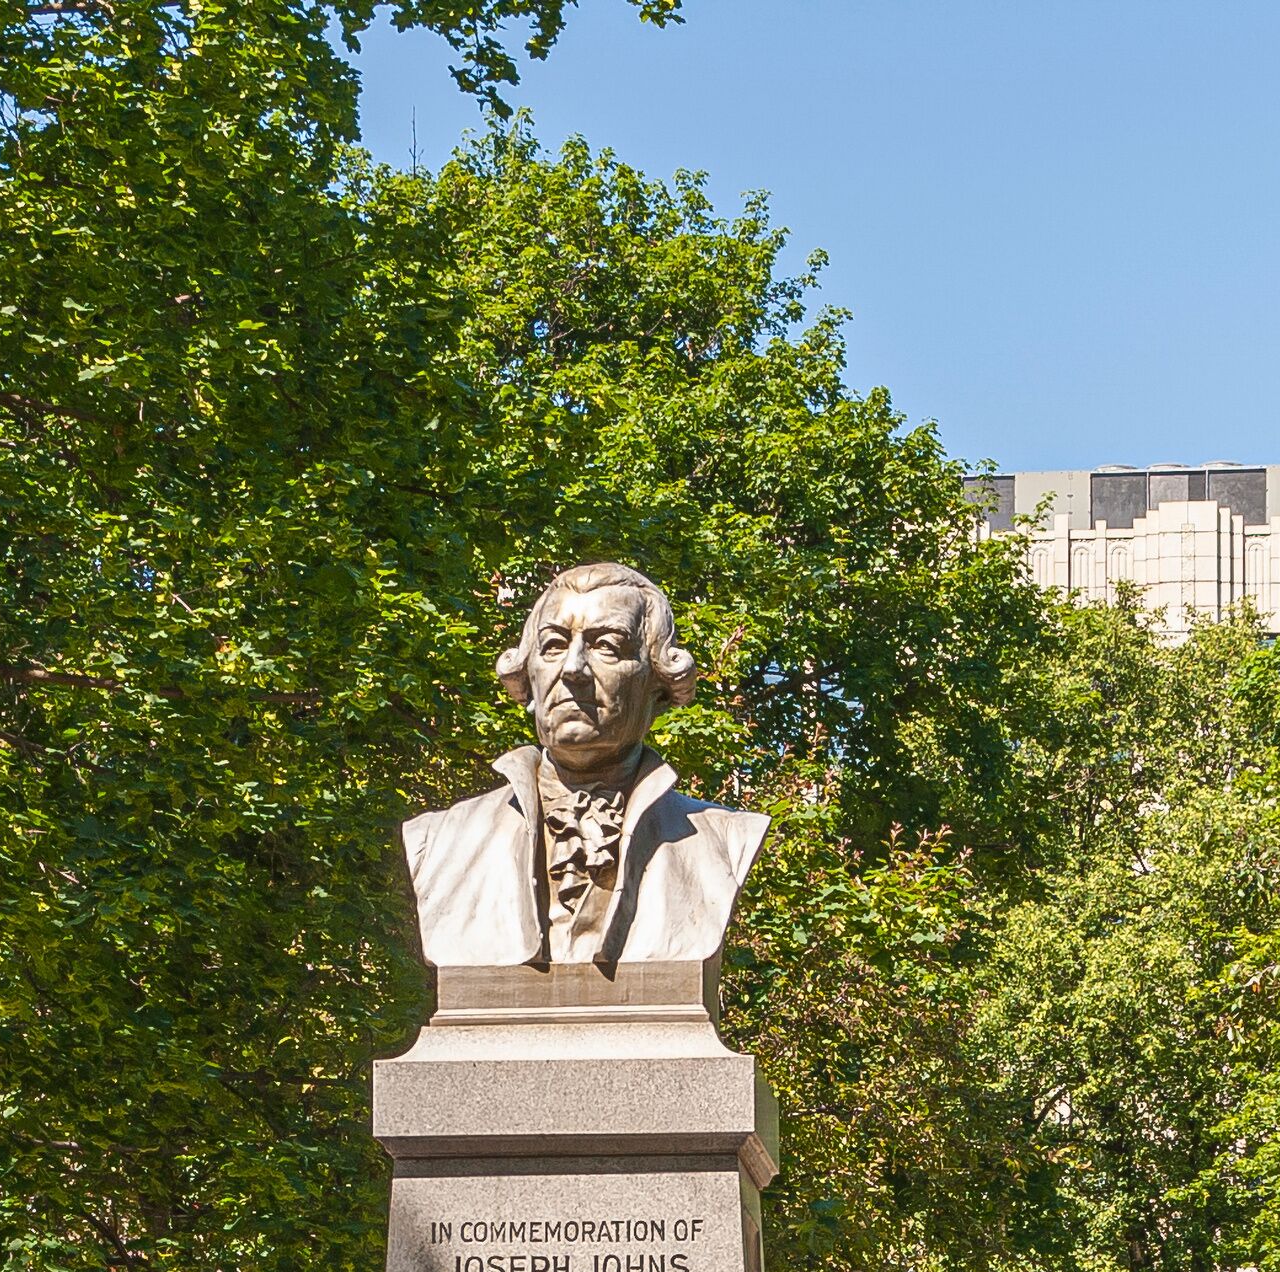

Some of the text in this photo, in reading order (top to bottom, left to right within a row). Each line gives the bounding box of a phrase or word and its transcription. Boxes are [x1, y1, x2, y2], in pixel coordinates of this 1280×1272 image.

[430, 1219, 704, 1244] IN COMMEMORATION OF
